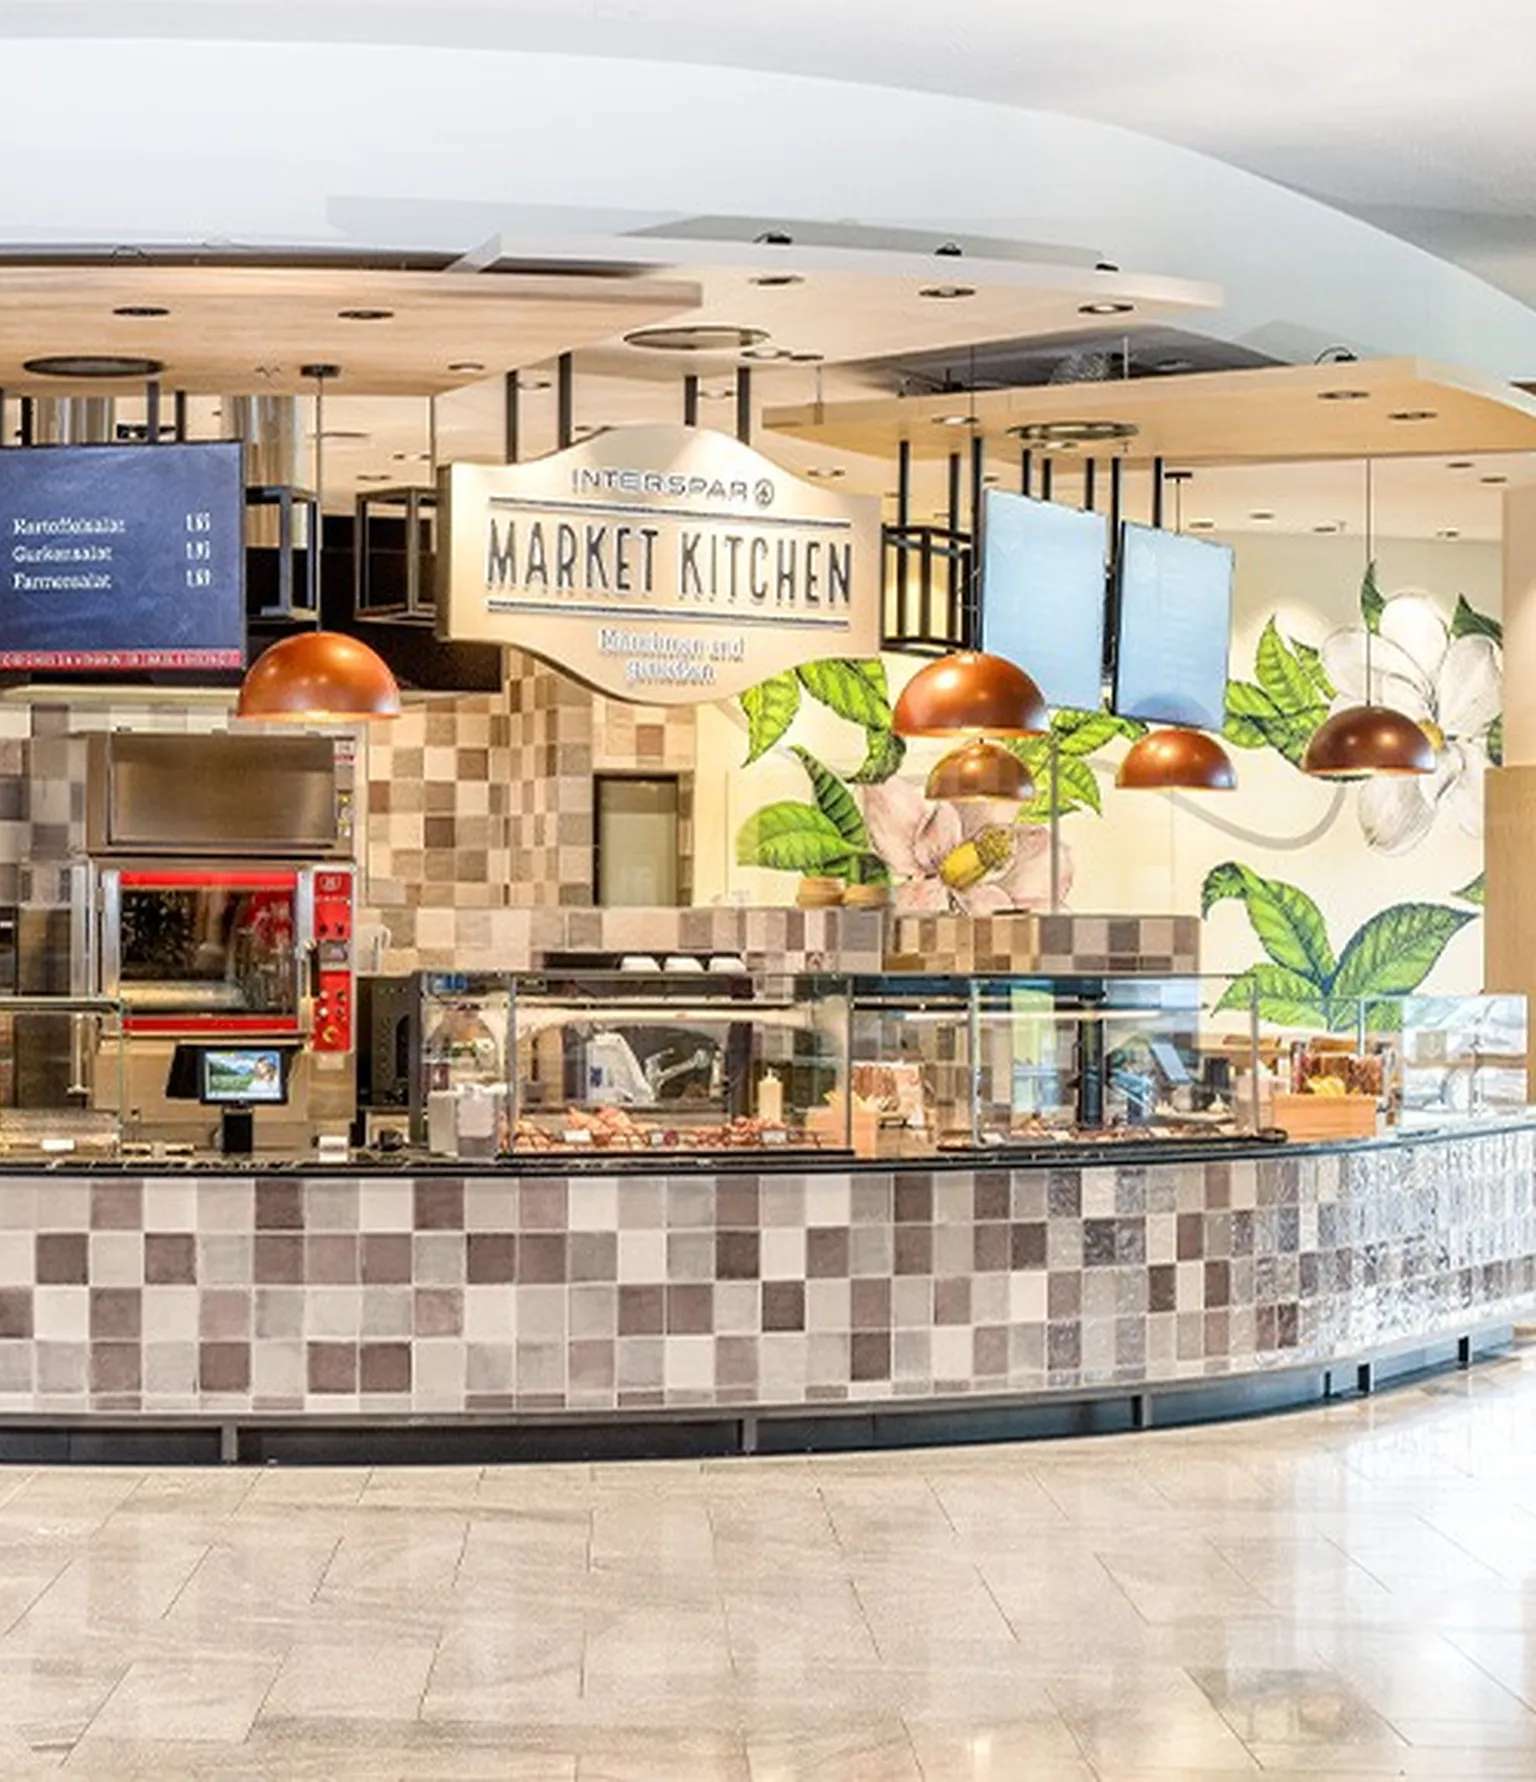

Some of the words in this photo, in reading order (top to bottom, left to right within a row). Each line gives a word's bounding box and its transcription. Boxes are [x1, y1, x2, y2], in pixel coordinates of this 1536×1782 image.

[571, 468, 748, 503] INTERSPAR
[12, 545, 113, 563] Gurkensalat
[487, 517, 659, 591] MARKET
[680, 531, 852, 605] KITCHEN
